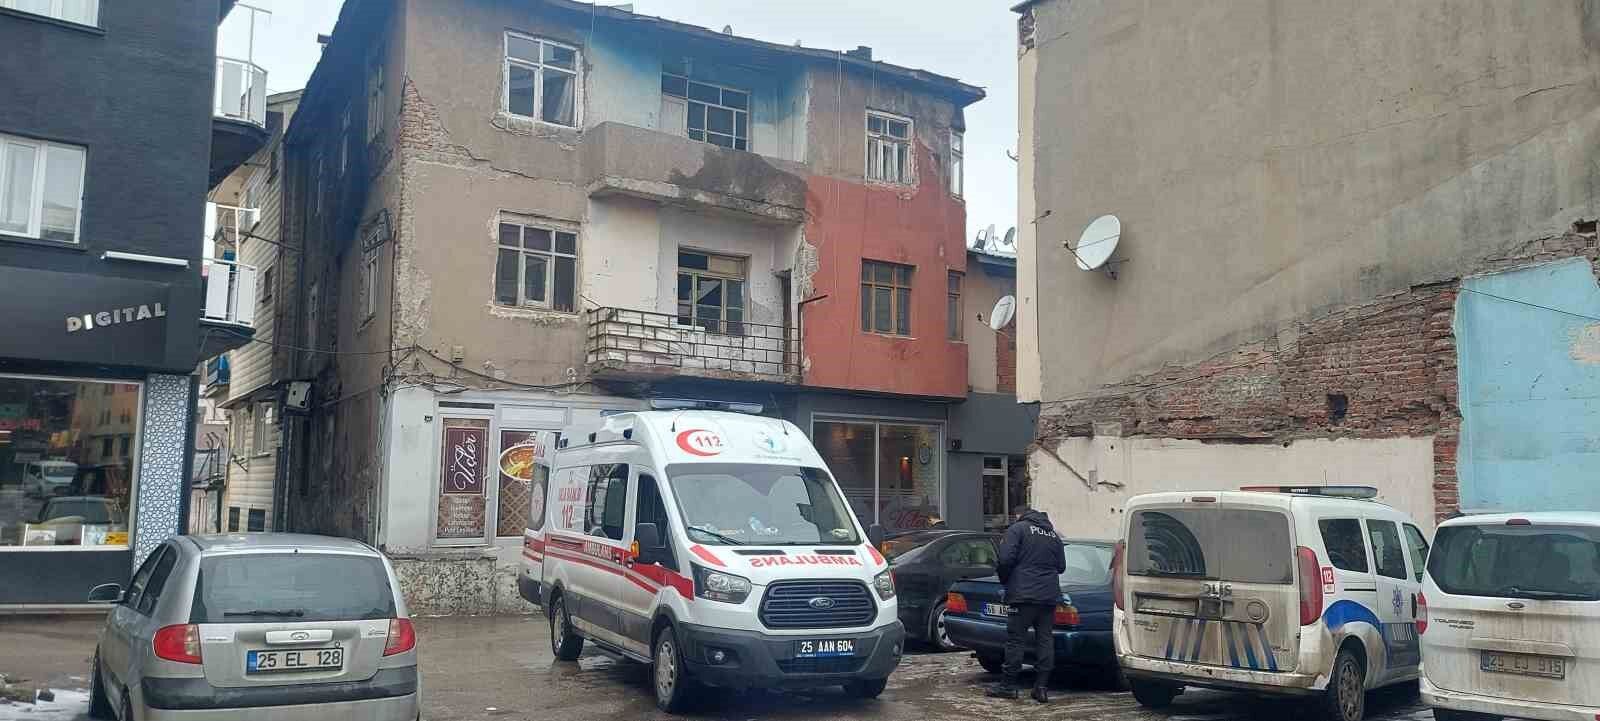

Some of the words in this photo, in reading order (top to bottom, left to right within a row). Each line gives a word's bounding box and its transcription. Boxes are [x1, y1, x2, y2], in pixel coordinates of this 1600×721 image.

[65, 302, 166, 332] DIGITAL
[695, 435, 723, 448] 112
[562, 504, 573, 529] 112
[801, 641, 813, 653] 25
[818, 640, 835, 652] AAN
[837, 640, 854, 652] 604
[258, 653, 277, 668] 25
[286, 652, 307, 667] EL
[317, 650, 341, 666] 128
